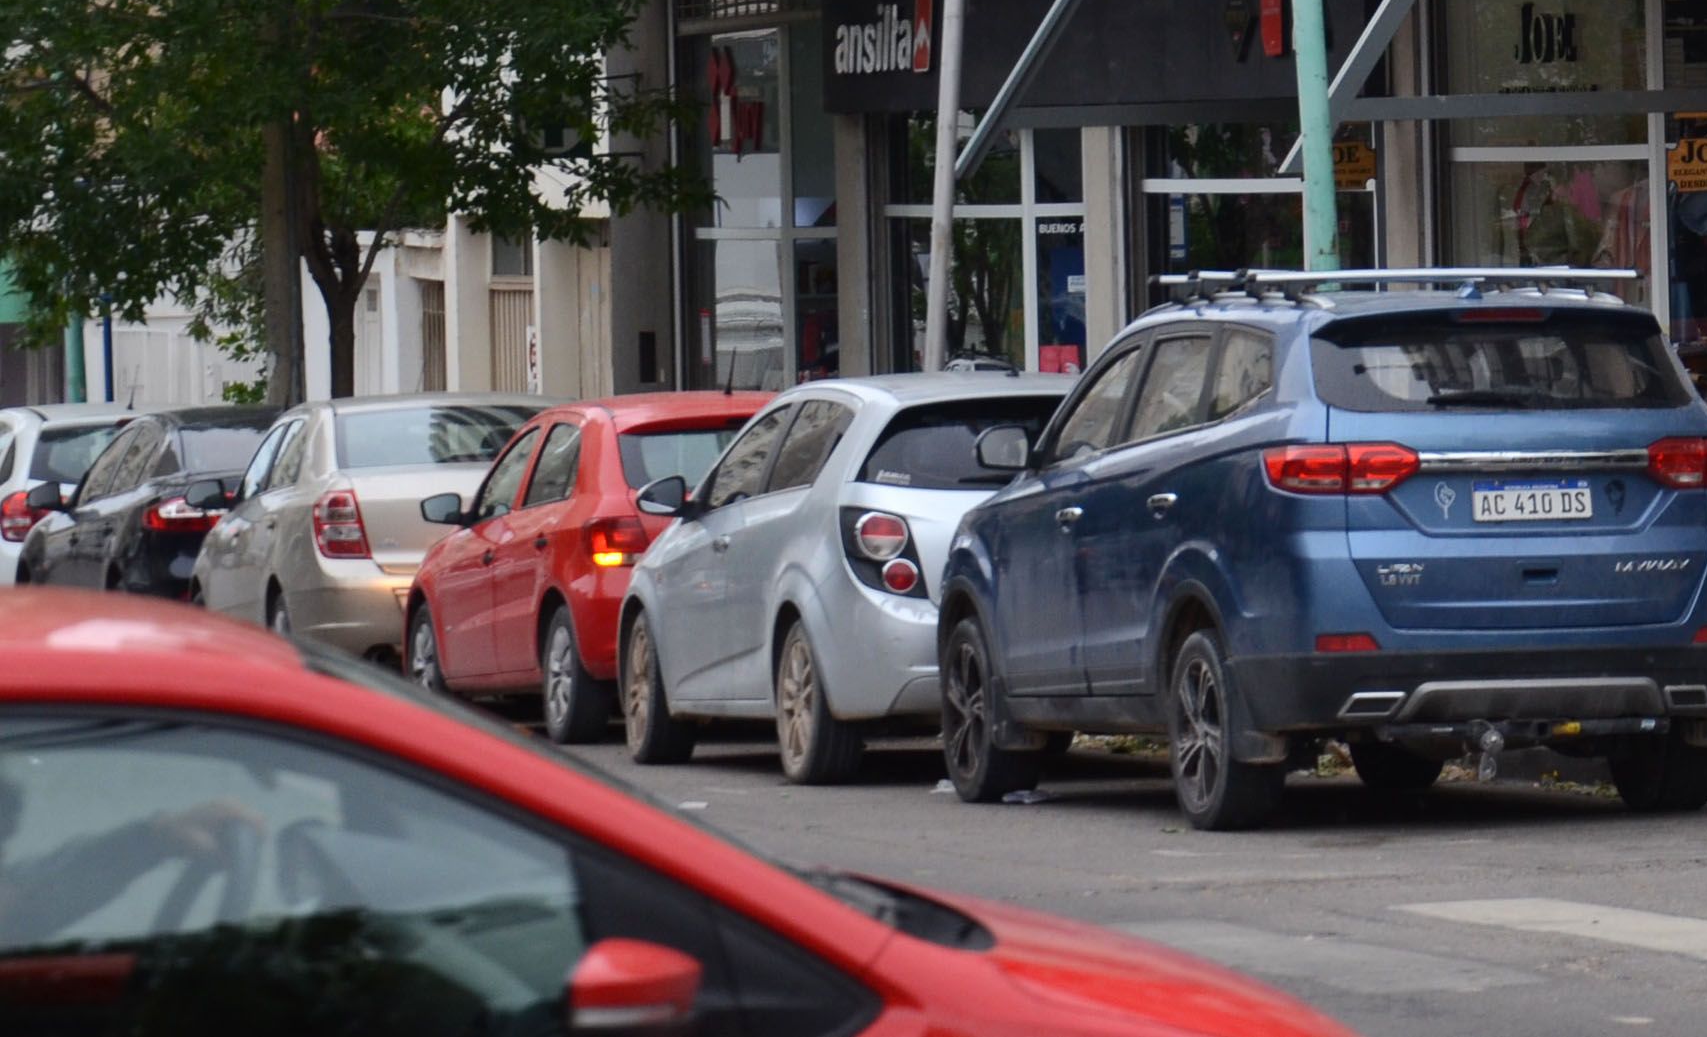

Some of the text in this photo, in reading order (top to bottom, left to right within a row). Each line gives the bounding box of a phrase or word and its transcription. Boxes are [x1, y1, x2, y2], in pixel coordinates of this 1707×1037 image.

[835, 3, 913, 74] ansilta
[1332, 144, 1361, 164] OE
[1481, 491, 1587, 516] AC 410 DS
